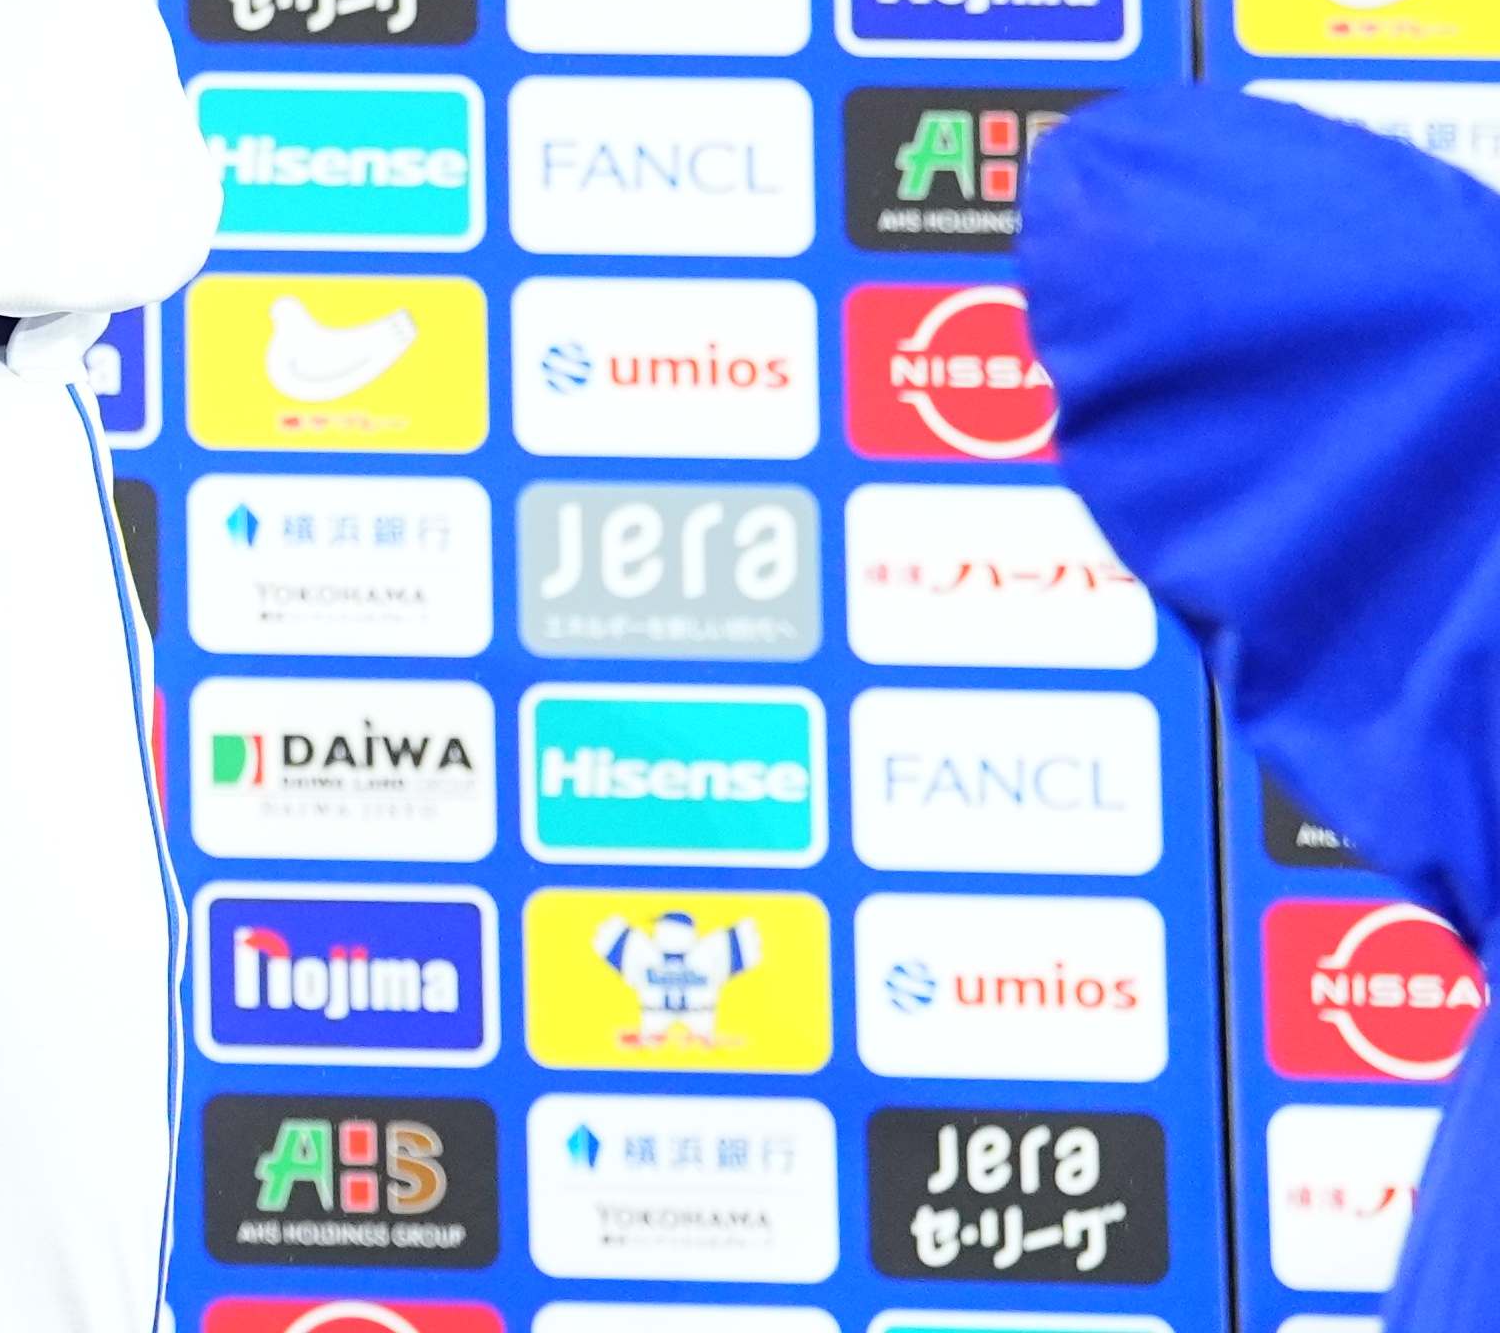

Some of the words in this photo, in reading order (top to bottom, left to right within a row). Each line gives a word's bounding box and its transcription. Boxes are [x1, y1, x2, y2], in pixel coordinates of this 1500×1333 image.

[540, 139, 778, 194] FANCL
[610, 344, 789, 388] umios
[281, 513, 449, 548] 横浜銀行
[544, 750, 813, 800] Hisense
[883, 753, 1125, 810] FANCL
[955, 963, 1138, 1009] umios
[623, 1134, 793, 1171] 横浜銀行
